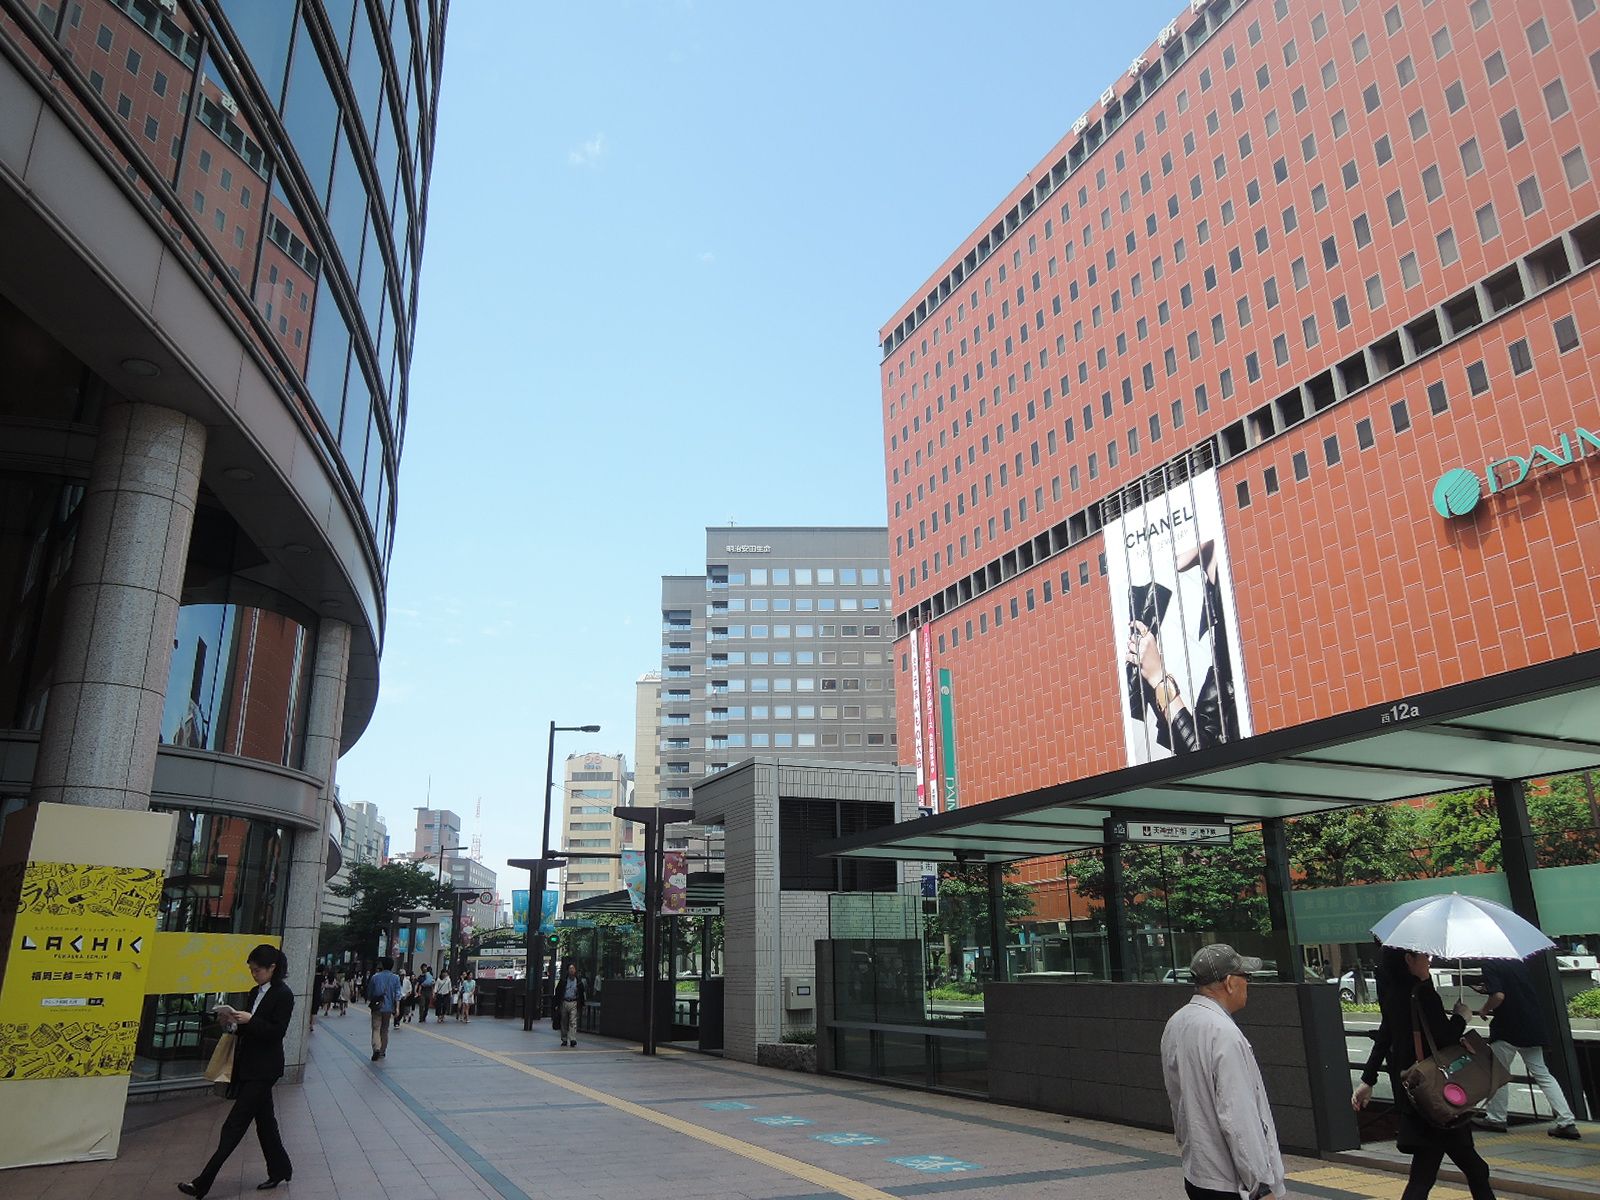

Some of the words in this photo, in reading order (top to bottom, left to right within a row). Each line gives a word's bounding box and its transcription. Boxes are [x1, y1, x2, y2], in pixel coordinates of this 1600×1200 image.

[1125, 506, 1193, 549] CHANEL
[725, 544, 772, 553] 明治安田生命
